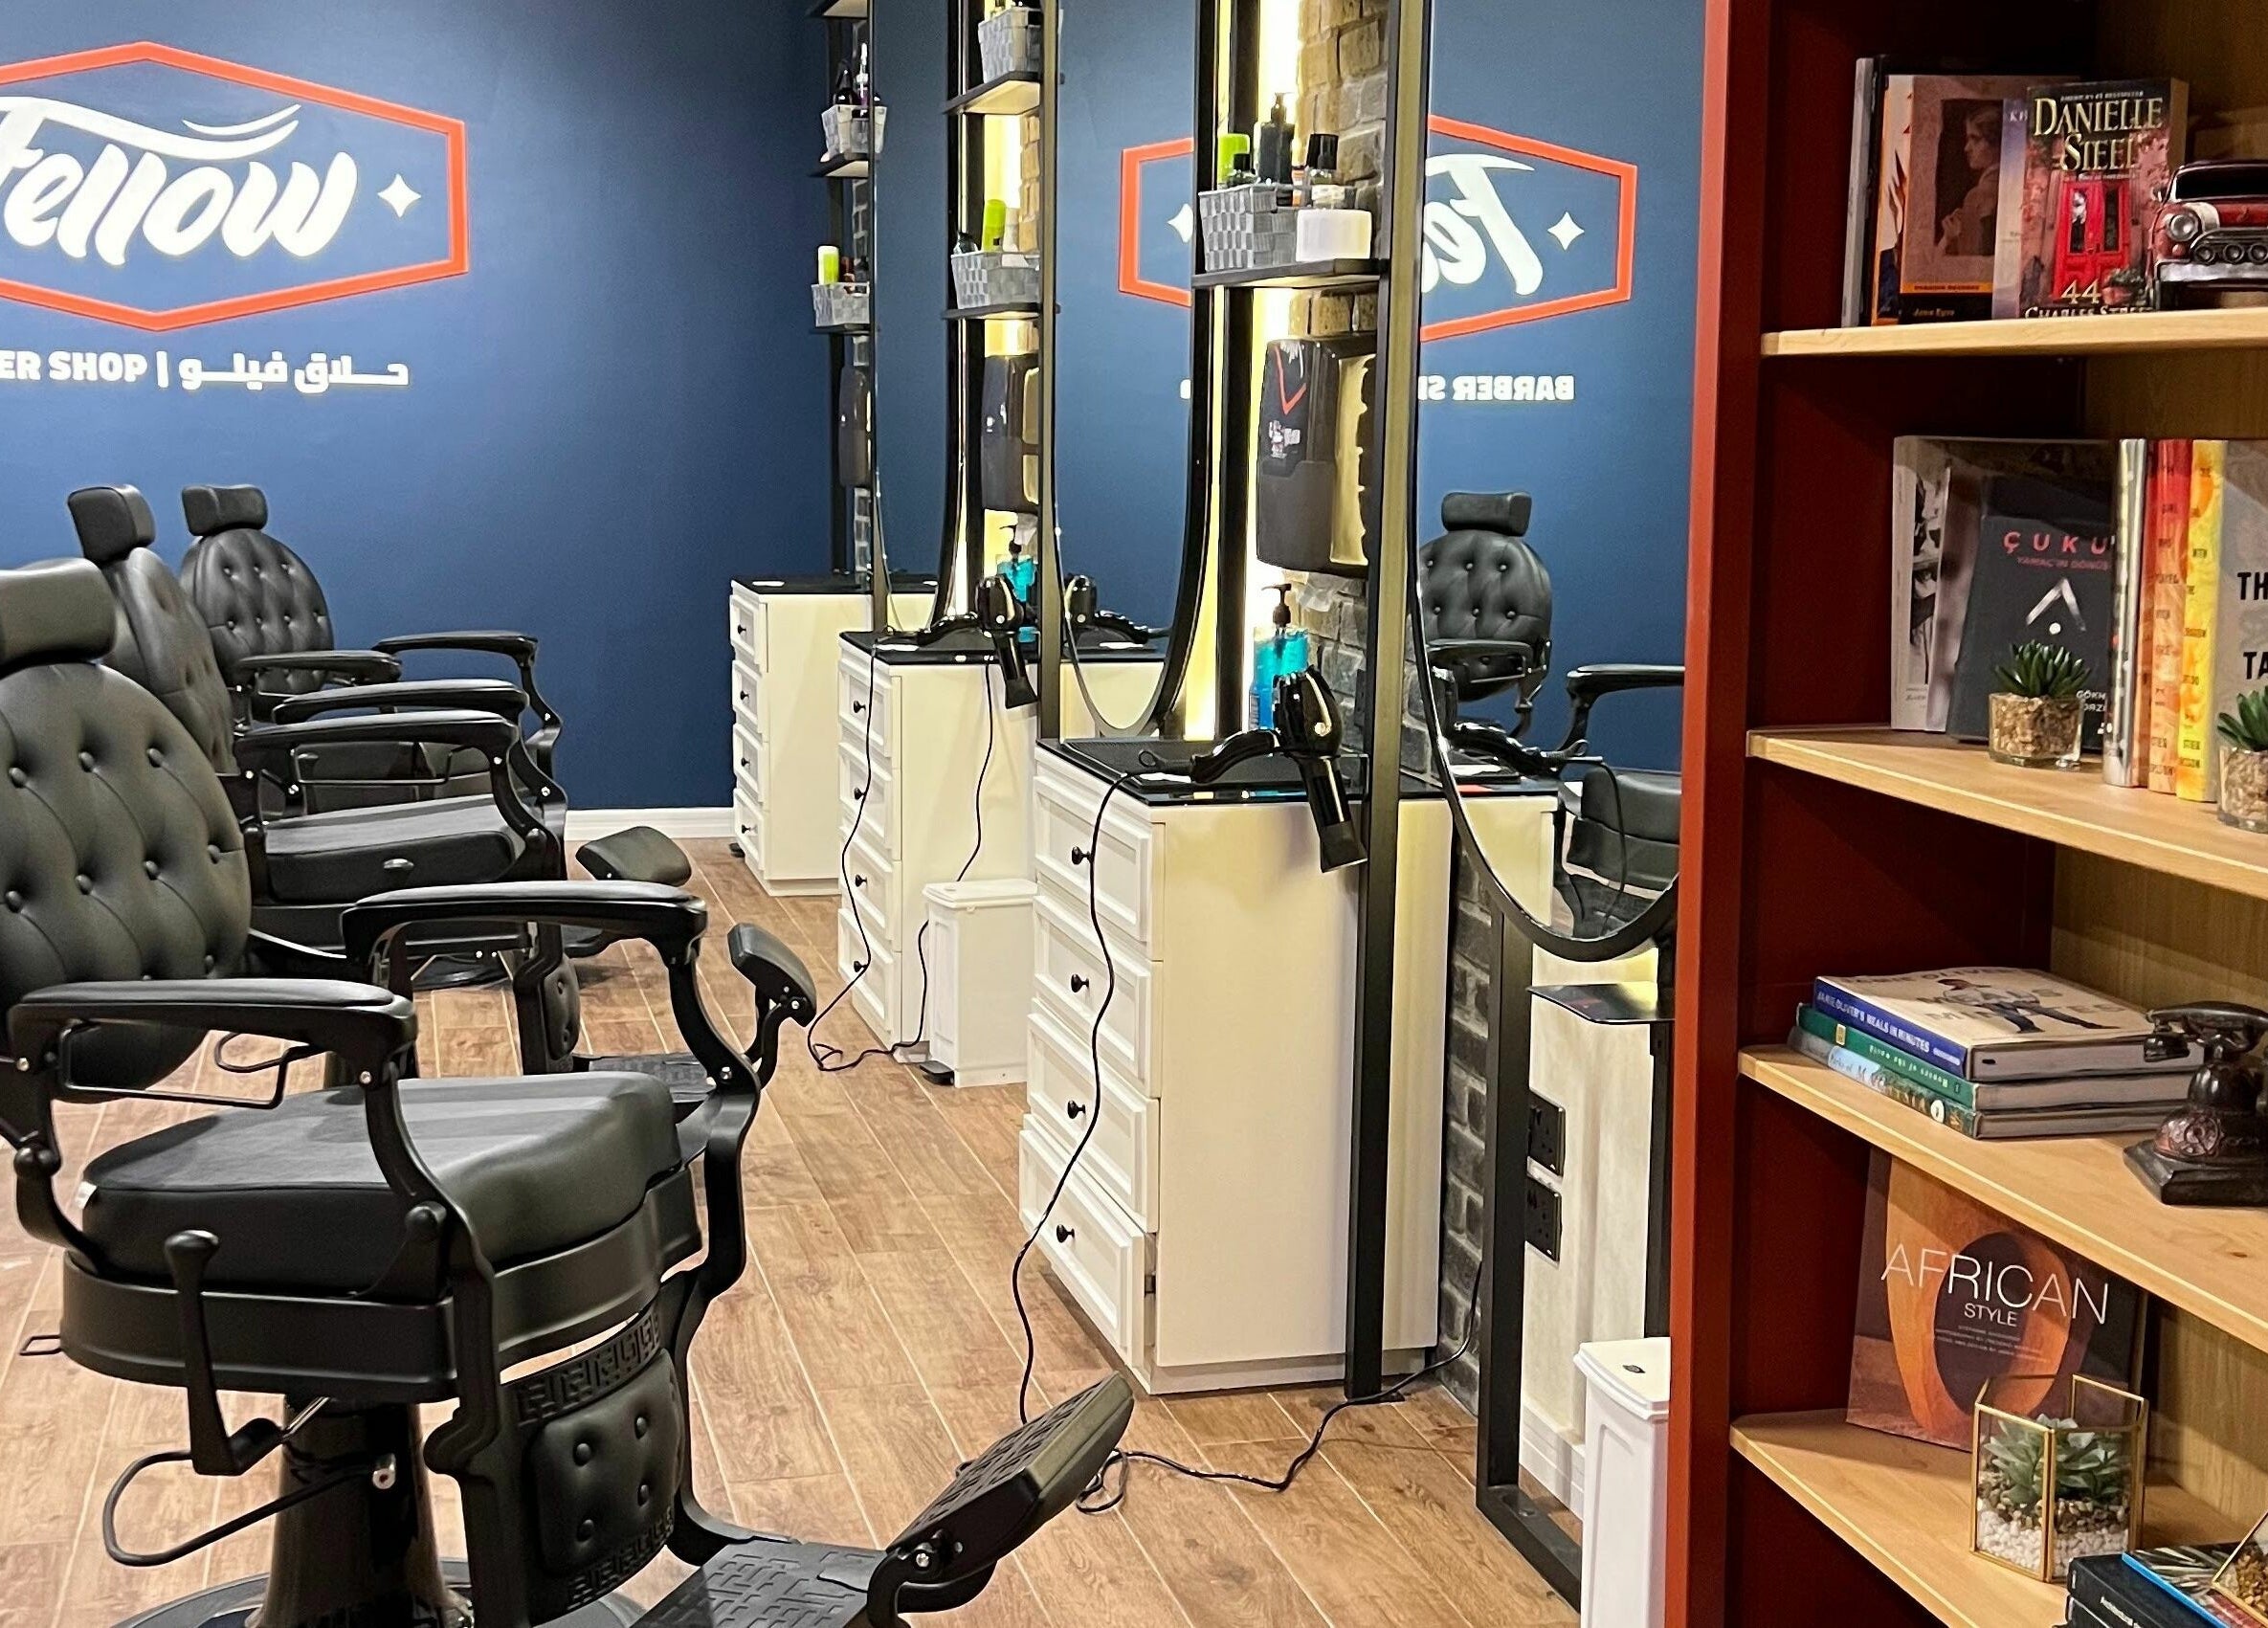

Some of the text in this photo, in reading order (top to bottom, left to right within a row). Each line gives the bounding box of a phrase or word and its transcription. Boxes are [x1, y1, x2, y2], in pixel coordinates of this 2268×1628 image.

[2035, 98, 2163, 135] DANIELLE
[2059, 133, 2140, 170] STEEL
[2060, 279, 2101, 304] 44
[48, 350, 147, 382] SHOP
[2003, 531, 2107, 555] ÇUKU
[1880, 1243, 2109, 1325] AFRICAN
[1964, 1303, 2018, 1327] STYLE
